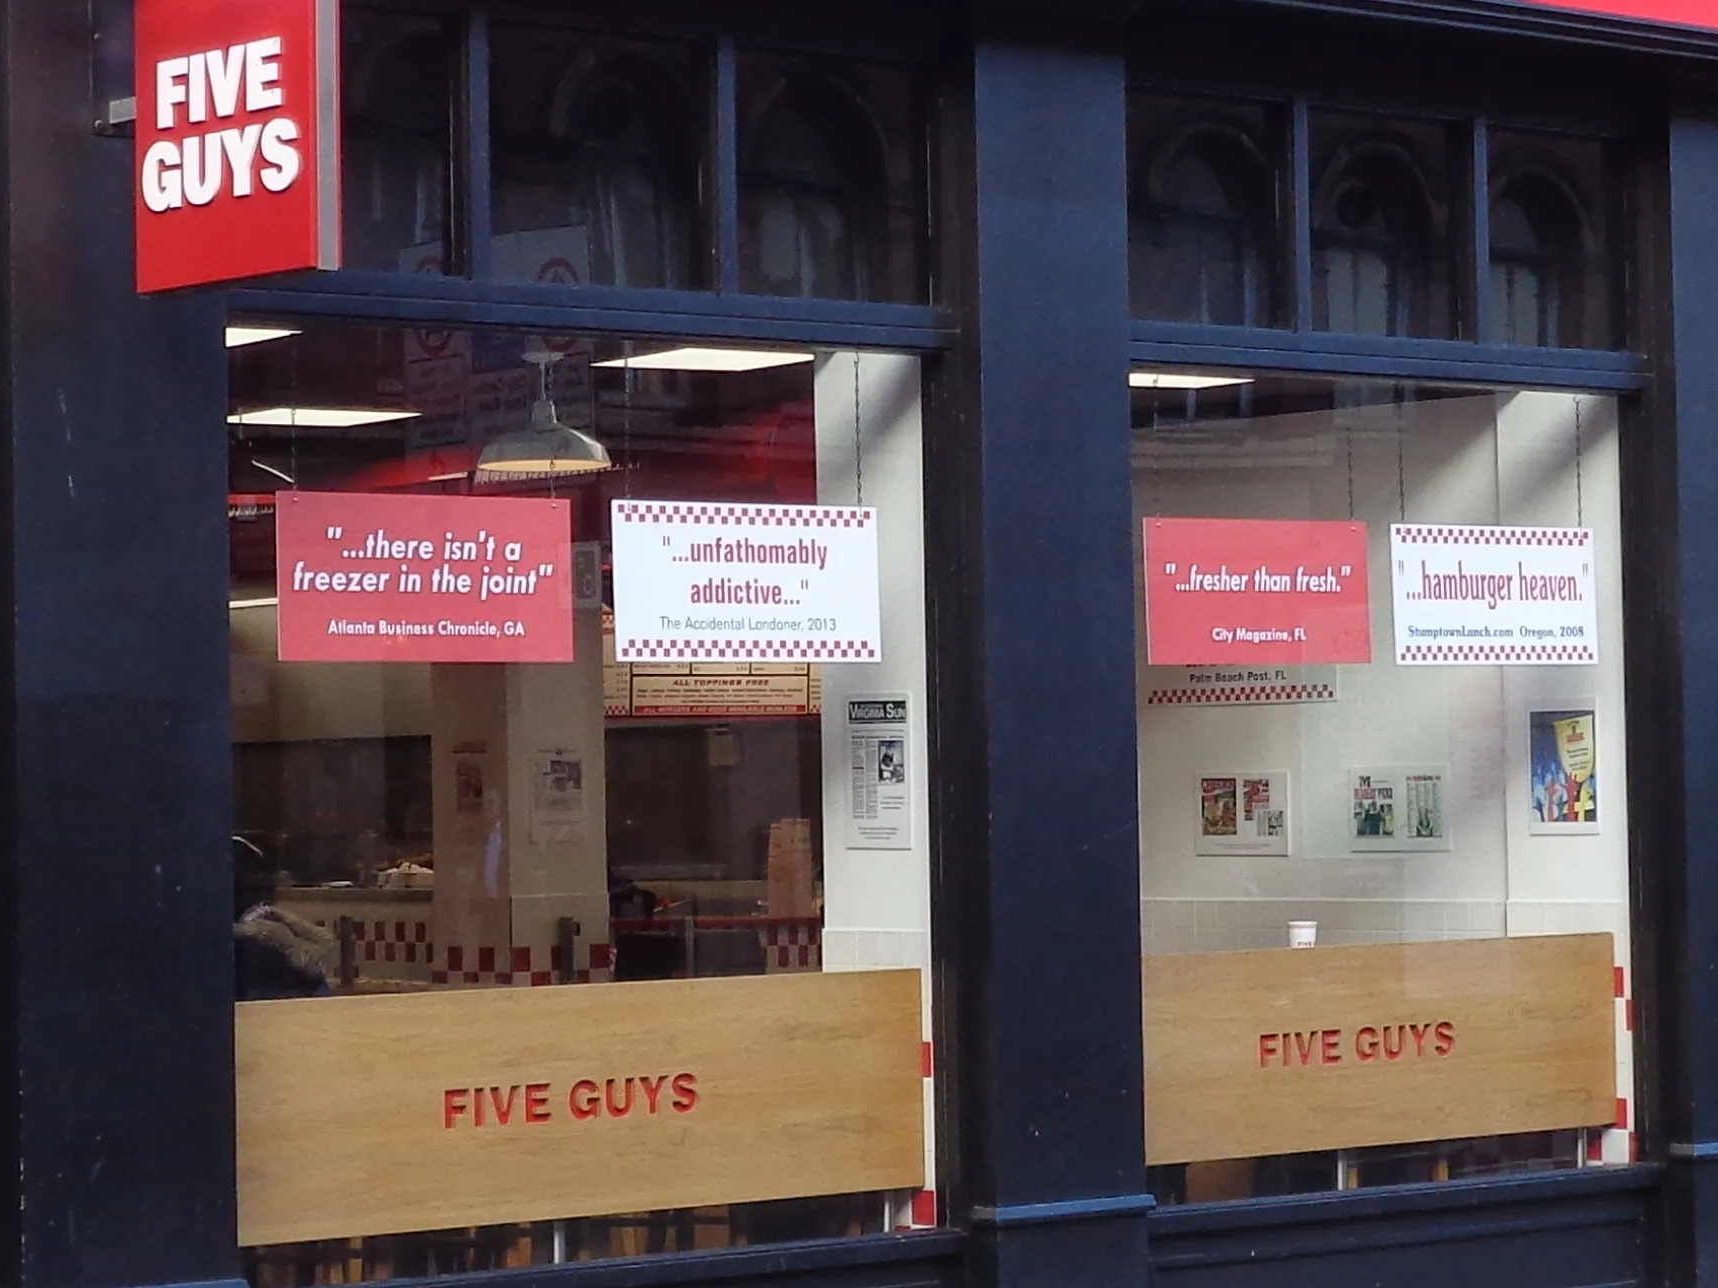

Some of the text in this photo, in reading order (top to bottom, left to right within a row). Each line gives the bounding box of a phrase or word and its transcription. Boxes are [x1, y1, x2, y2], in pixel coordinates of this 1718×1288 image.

[156, 37, 283, 130] FIVE
[141, 118, 299, 212] GUYS
[326, 526, 521, 561] "...there isn't a
[663, 535, 828, 570] "...unfathomably
[293, 561, 553, 600] freezer in the joint"
[690, 578, 809, 605] addictive..."
[1165, 563, 1352, 593] "...fresher than fresh."
[1519, 561, 1589, 601] heaven."
[328, 620, 525, 637] Atlanta Business Chronicle, GA
[659, 616, 836, 632] The Accidental Londoner, 2013
[1211, 627, 1307, 643] City Magazine, FL
[1408, 625, 1584, 639] StumptownLunch.com Oregon, 2008
[1189, 674, 1211, 684] Palm
[1216, 672, 1243, 683] Beach
[1275, 670, 1287, 680] FL
[1259, 1021, 1456, 1068] FIVE GUYS
[444, 1072, 698, 1129] FIVE GUYS
